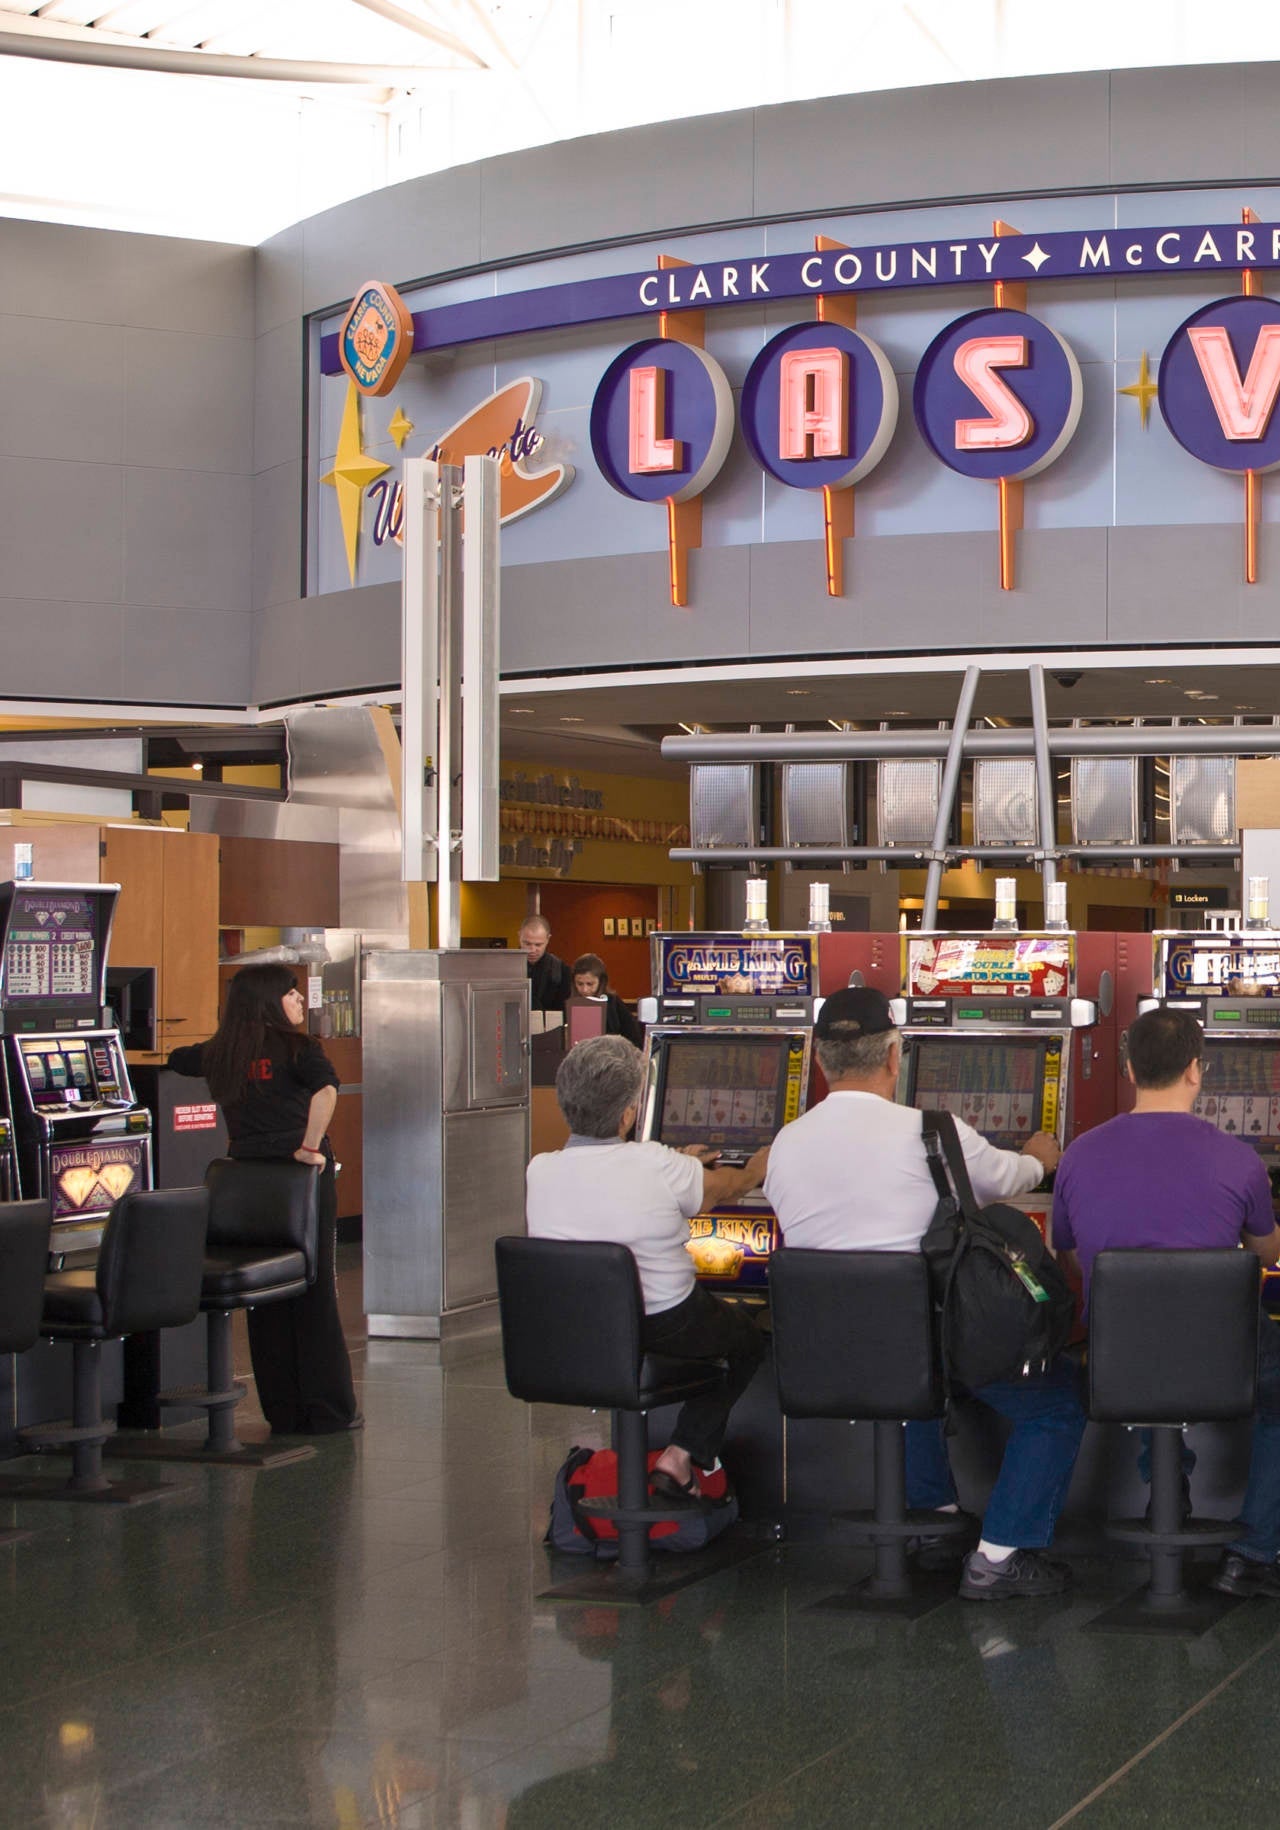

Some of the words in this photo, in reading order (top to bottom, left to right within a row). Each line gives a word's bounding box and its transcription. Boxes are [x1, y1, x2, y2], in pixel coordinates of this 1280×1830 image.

[638, 262, 771, 308] CLARK
[801, 242, 1001, 288] COUNTY
[347, 298, 368, 340] CLARK
[369, 292, 396, 331] COUNTY
[355, 357, 388, 383] NEVADA
[628, 335, 1034, 475] LAS
[1184, 894, 1209, 902] Lockers
[667, 950, 740, 981] GAME
[742, 950, 807, 982] KING
[990, 971, 1031, 981] POKER
[53, 1152, 92, 1174] DOUBLE
[92, 1149, 142, 1170] DIAMOND
[716, 1219, 770, 1255] KING
